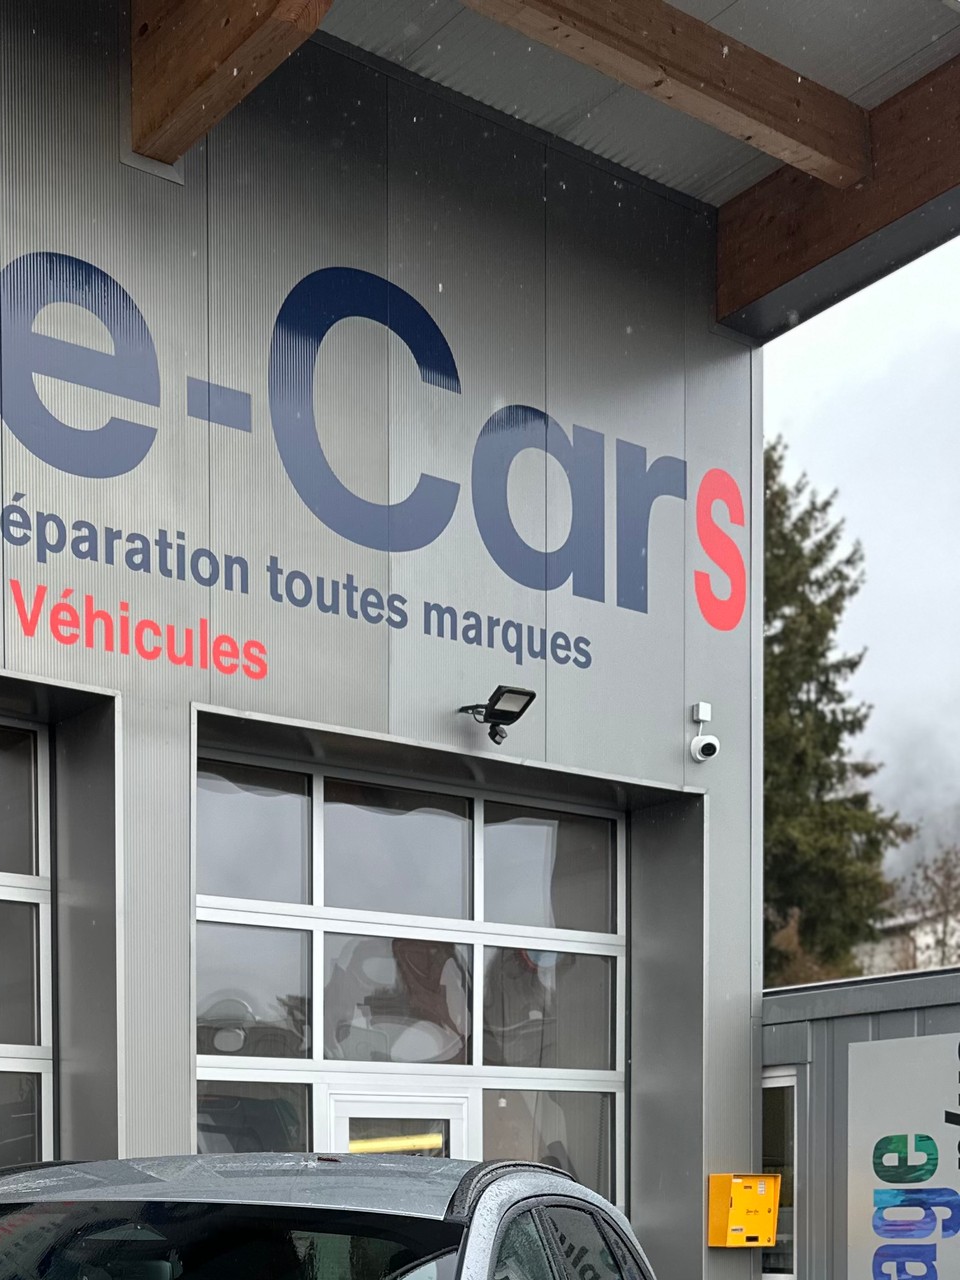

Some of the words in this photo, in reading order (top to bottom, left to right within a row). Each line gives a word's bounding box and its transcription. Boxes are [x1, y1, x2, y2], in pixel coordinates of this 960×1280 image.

[10, 578, 269, 681] Véhicules
[268, 559, 409, 629] toutes
[424, 603, 592, 669] marques
